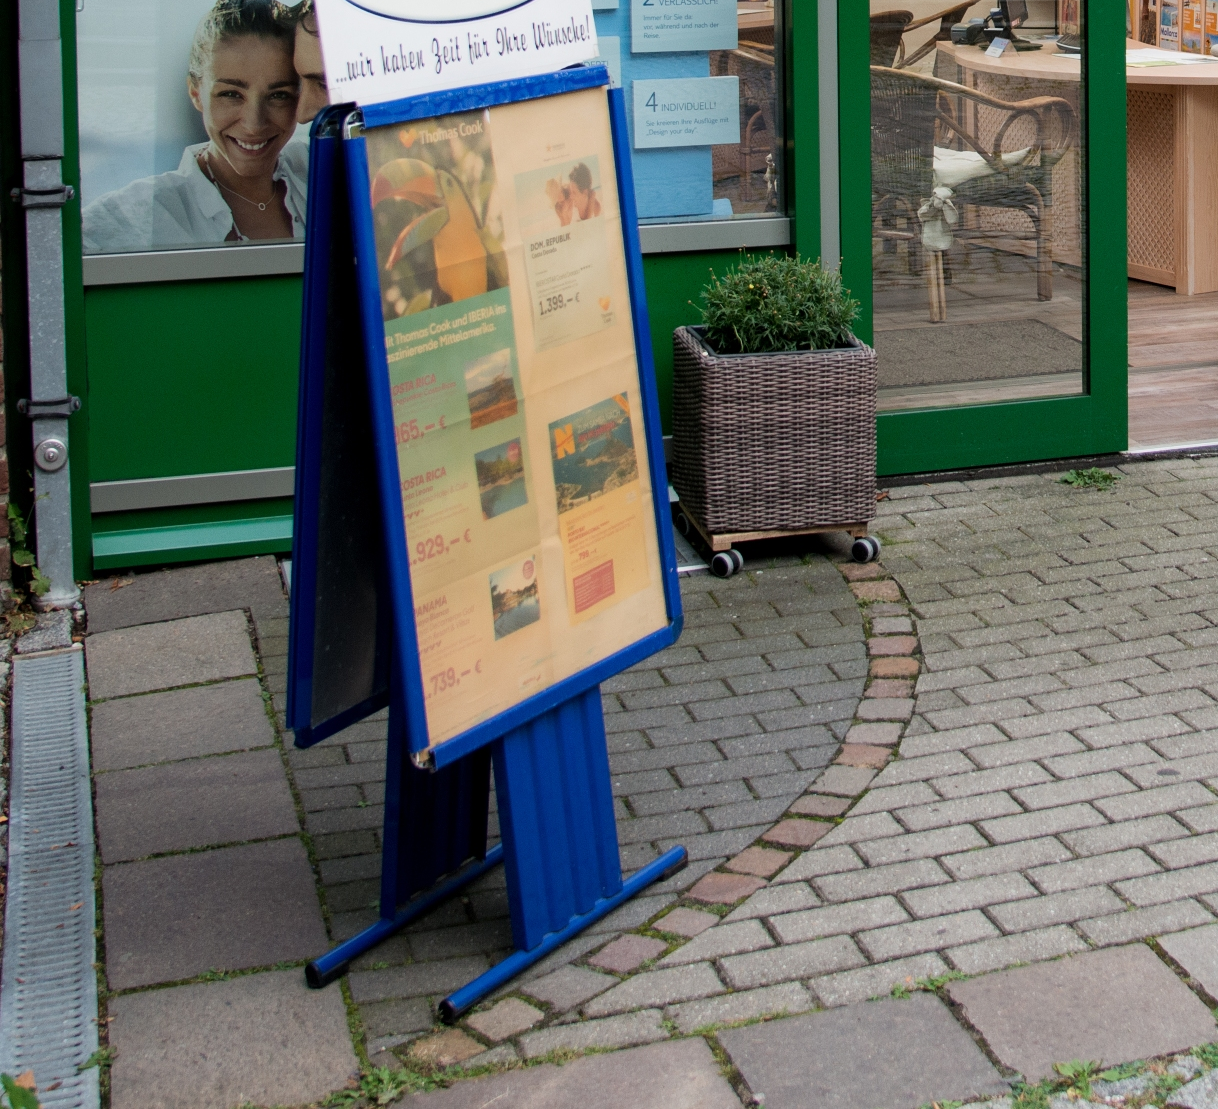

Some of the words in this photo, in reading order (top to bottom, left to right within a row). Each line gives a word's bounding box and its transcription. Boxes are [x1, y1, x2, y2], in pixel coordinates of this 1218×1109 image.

[380, 43, 426, 75] haben
[431, 37, 462, 74] Zeit
[467, 31, 490, 65] für
[495, 26, 528, 56] Ihre
[532, 14, 591, 51] Wünsche!
[645, 91, 658, 112] 4
[661, 102, 717, 112] INDIVIDUELL!
[419, 127, 459, 145] Thomas
[460, 120, 484, 137] Cook
[530, 240, 546, 252] DOM.
[546, 232, 571, 247] REPUBLIK
[575, 292, 581, 303] €
[394, 328, 429, 345] Thomas
[429, 319, 452, 335] Cook
[452, 316, 468, 328] und
[468, 306, 496, 323] IBERIA
[439, 322, 497, 347] Mittelamerika.
[391, 379, 414, 397] OSTA
[425, 466, 447, 483] RICA
[463, 528, 472, 543] €
[414, 594, 448, 617] ANAMA
